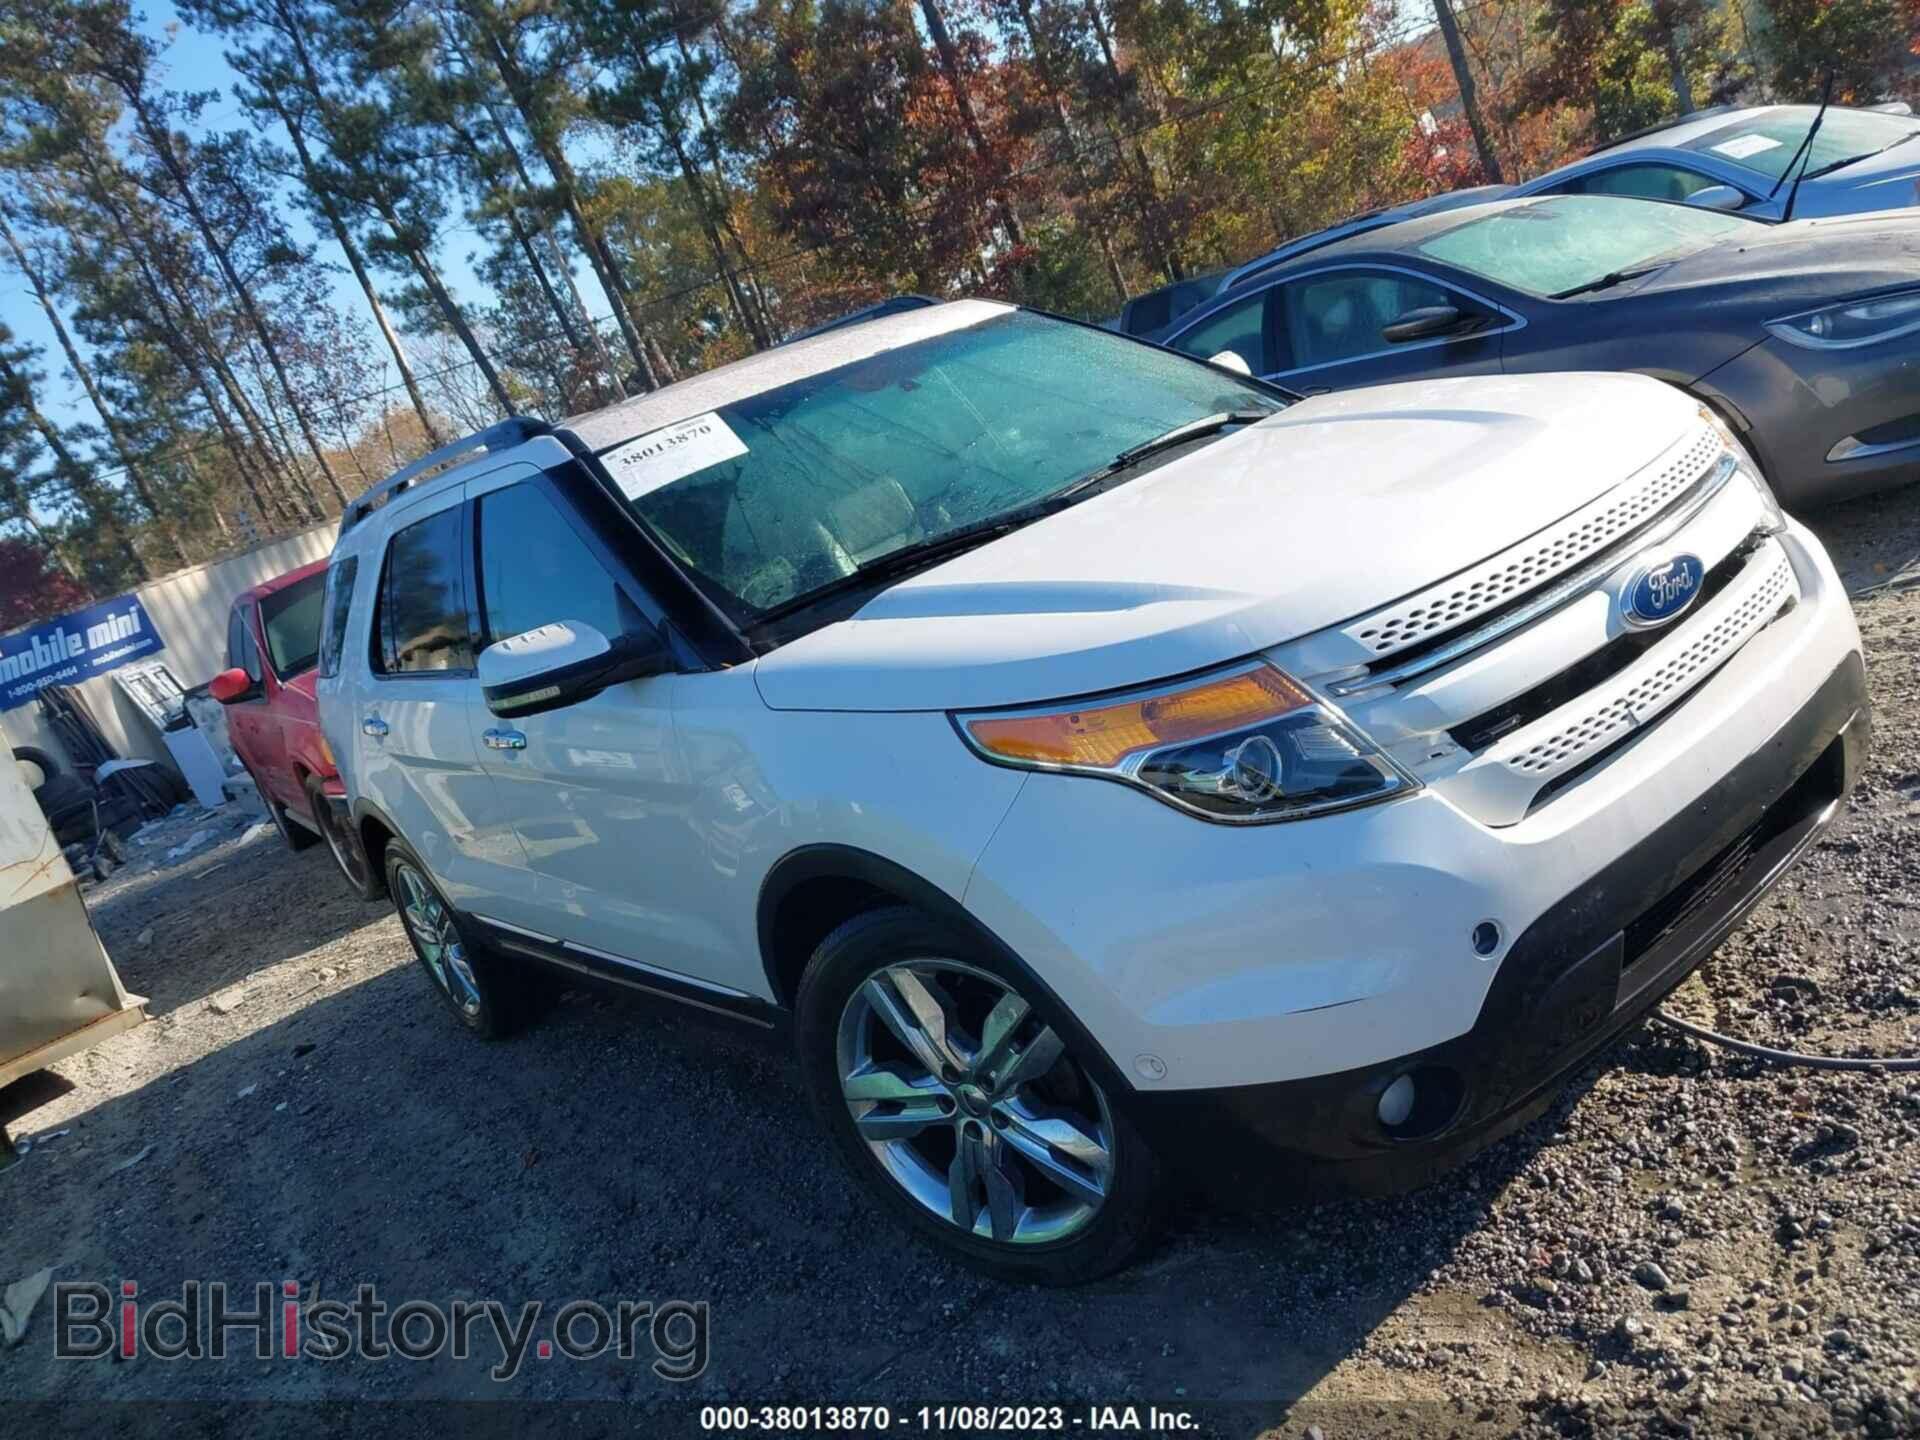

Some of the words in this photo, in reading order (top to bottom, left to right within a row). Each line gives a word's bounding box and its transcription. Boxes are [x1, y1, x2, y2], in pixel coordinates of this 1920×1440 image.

[620, 425, 711, 465] 38013870
[1648, 562, 1693, 609] Ford
[0, 627, 85, 683] mobile
[87, 605, 141, 649] mini
